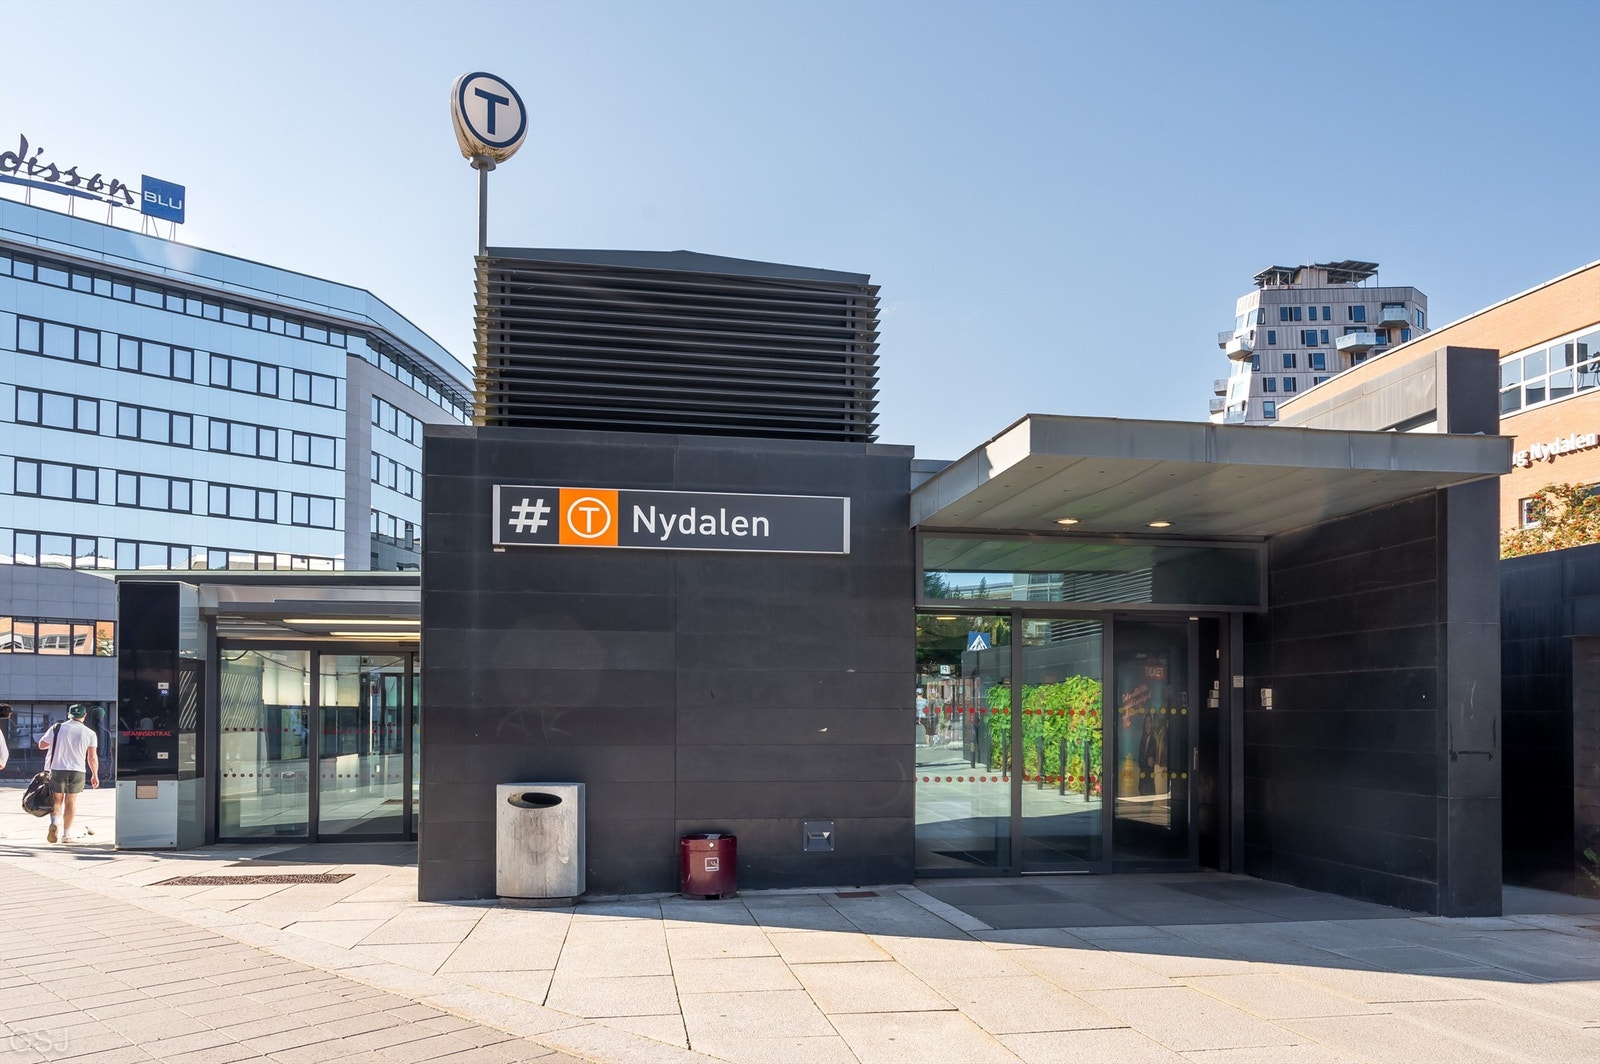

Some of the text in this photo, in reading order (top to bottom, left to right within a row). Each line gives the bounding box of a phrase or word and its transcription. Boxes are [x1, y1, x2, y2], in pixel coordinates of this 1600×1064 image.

[144, 190, 182, 210] BLU
[1530, 432, 1597, 462] Nydalen
[632, 505, 770, 541] Nydalen
